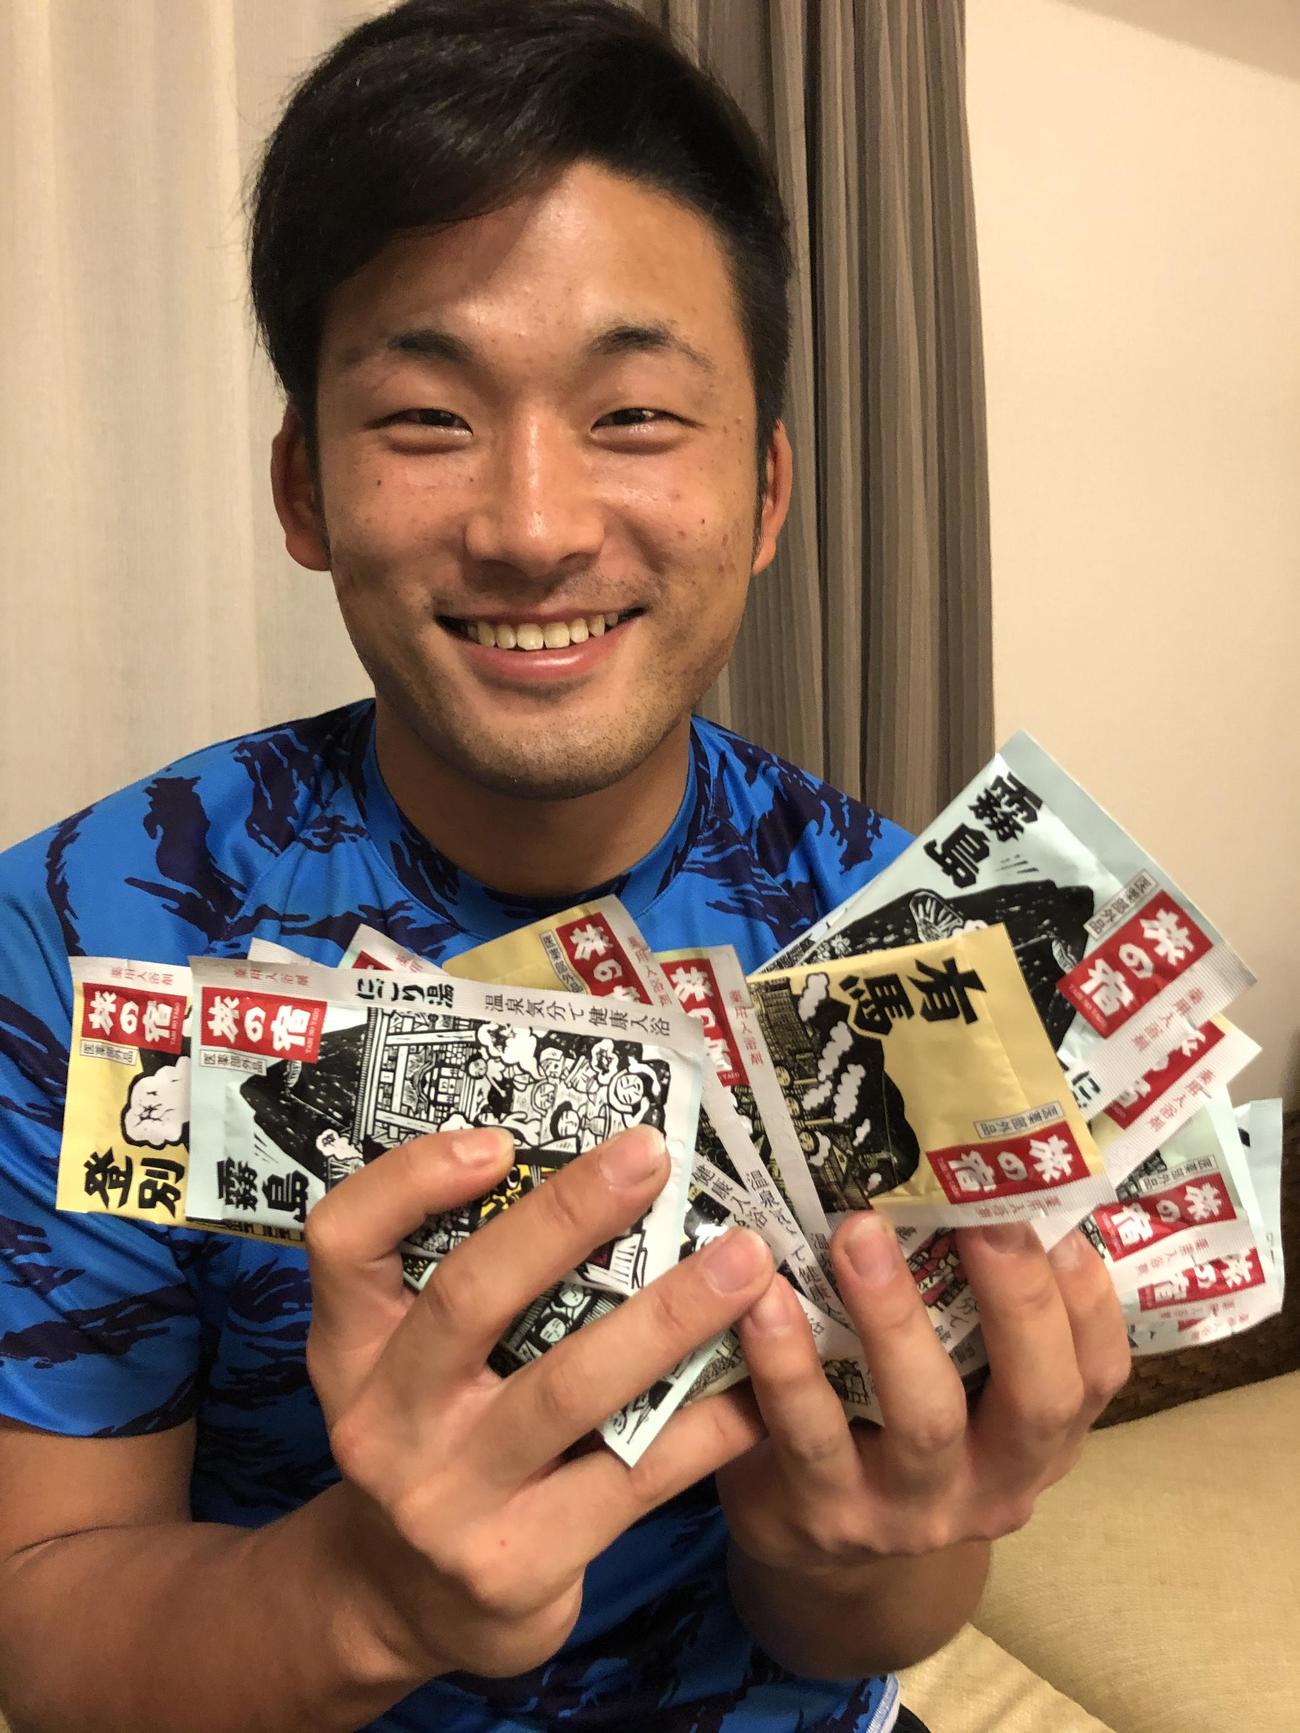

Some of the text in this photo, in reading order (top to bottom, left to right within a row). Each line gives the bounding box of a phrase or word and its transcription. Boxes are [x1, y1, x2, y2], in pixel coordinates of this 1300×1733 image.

[924, 772, 1043, 889] 霧島
[356, 978, 454, 1009] にごり湯
[839, 957, 987, 1036] 有馬
[1080, 908, 1194, 1018] 旅の宿
[88, 990, 174, 1043] 旅の宿
[207, 994, 311, 1053] 旅の宿
[485, 993, 672, 1037] 温泉気分で健康入浴
[84, 1147, 185, 1218] 登別
[216, 1156, 310, 1223] 霧島
[948, 1134, 1073, 1193] 旅の宿
[1110, 1181, 1223, 1248] 旅の宿
